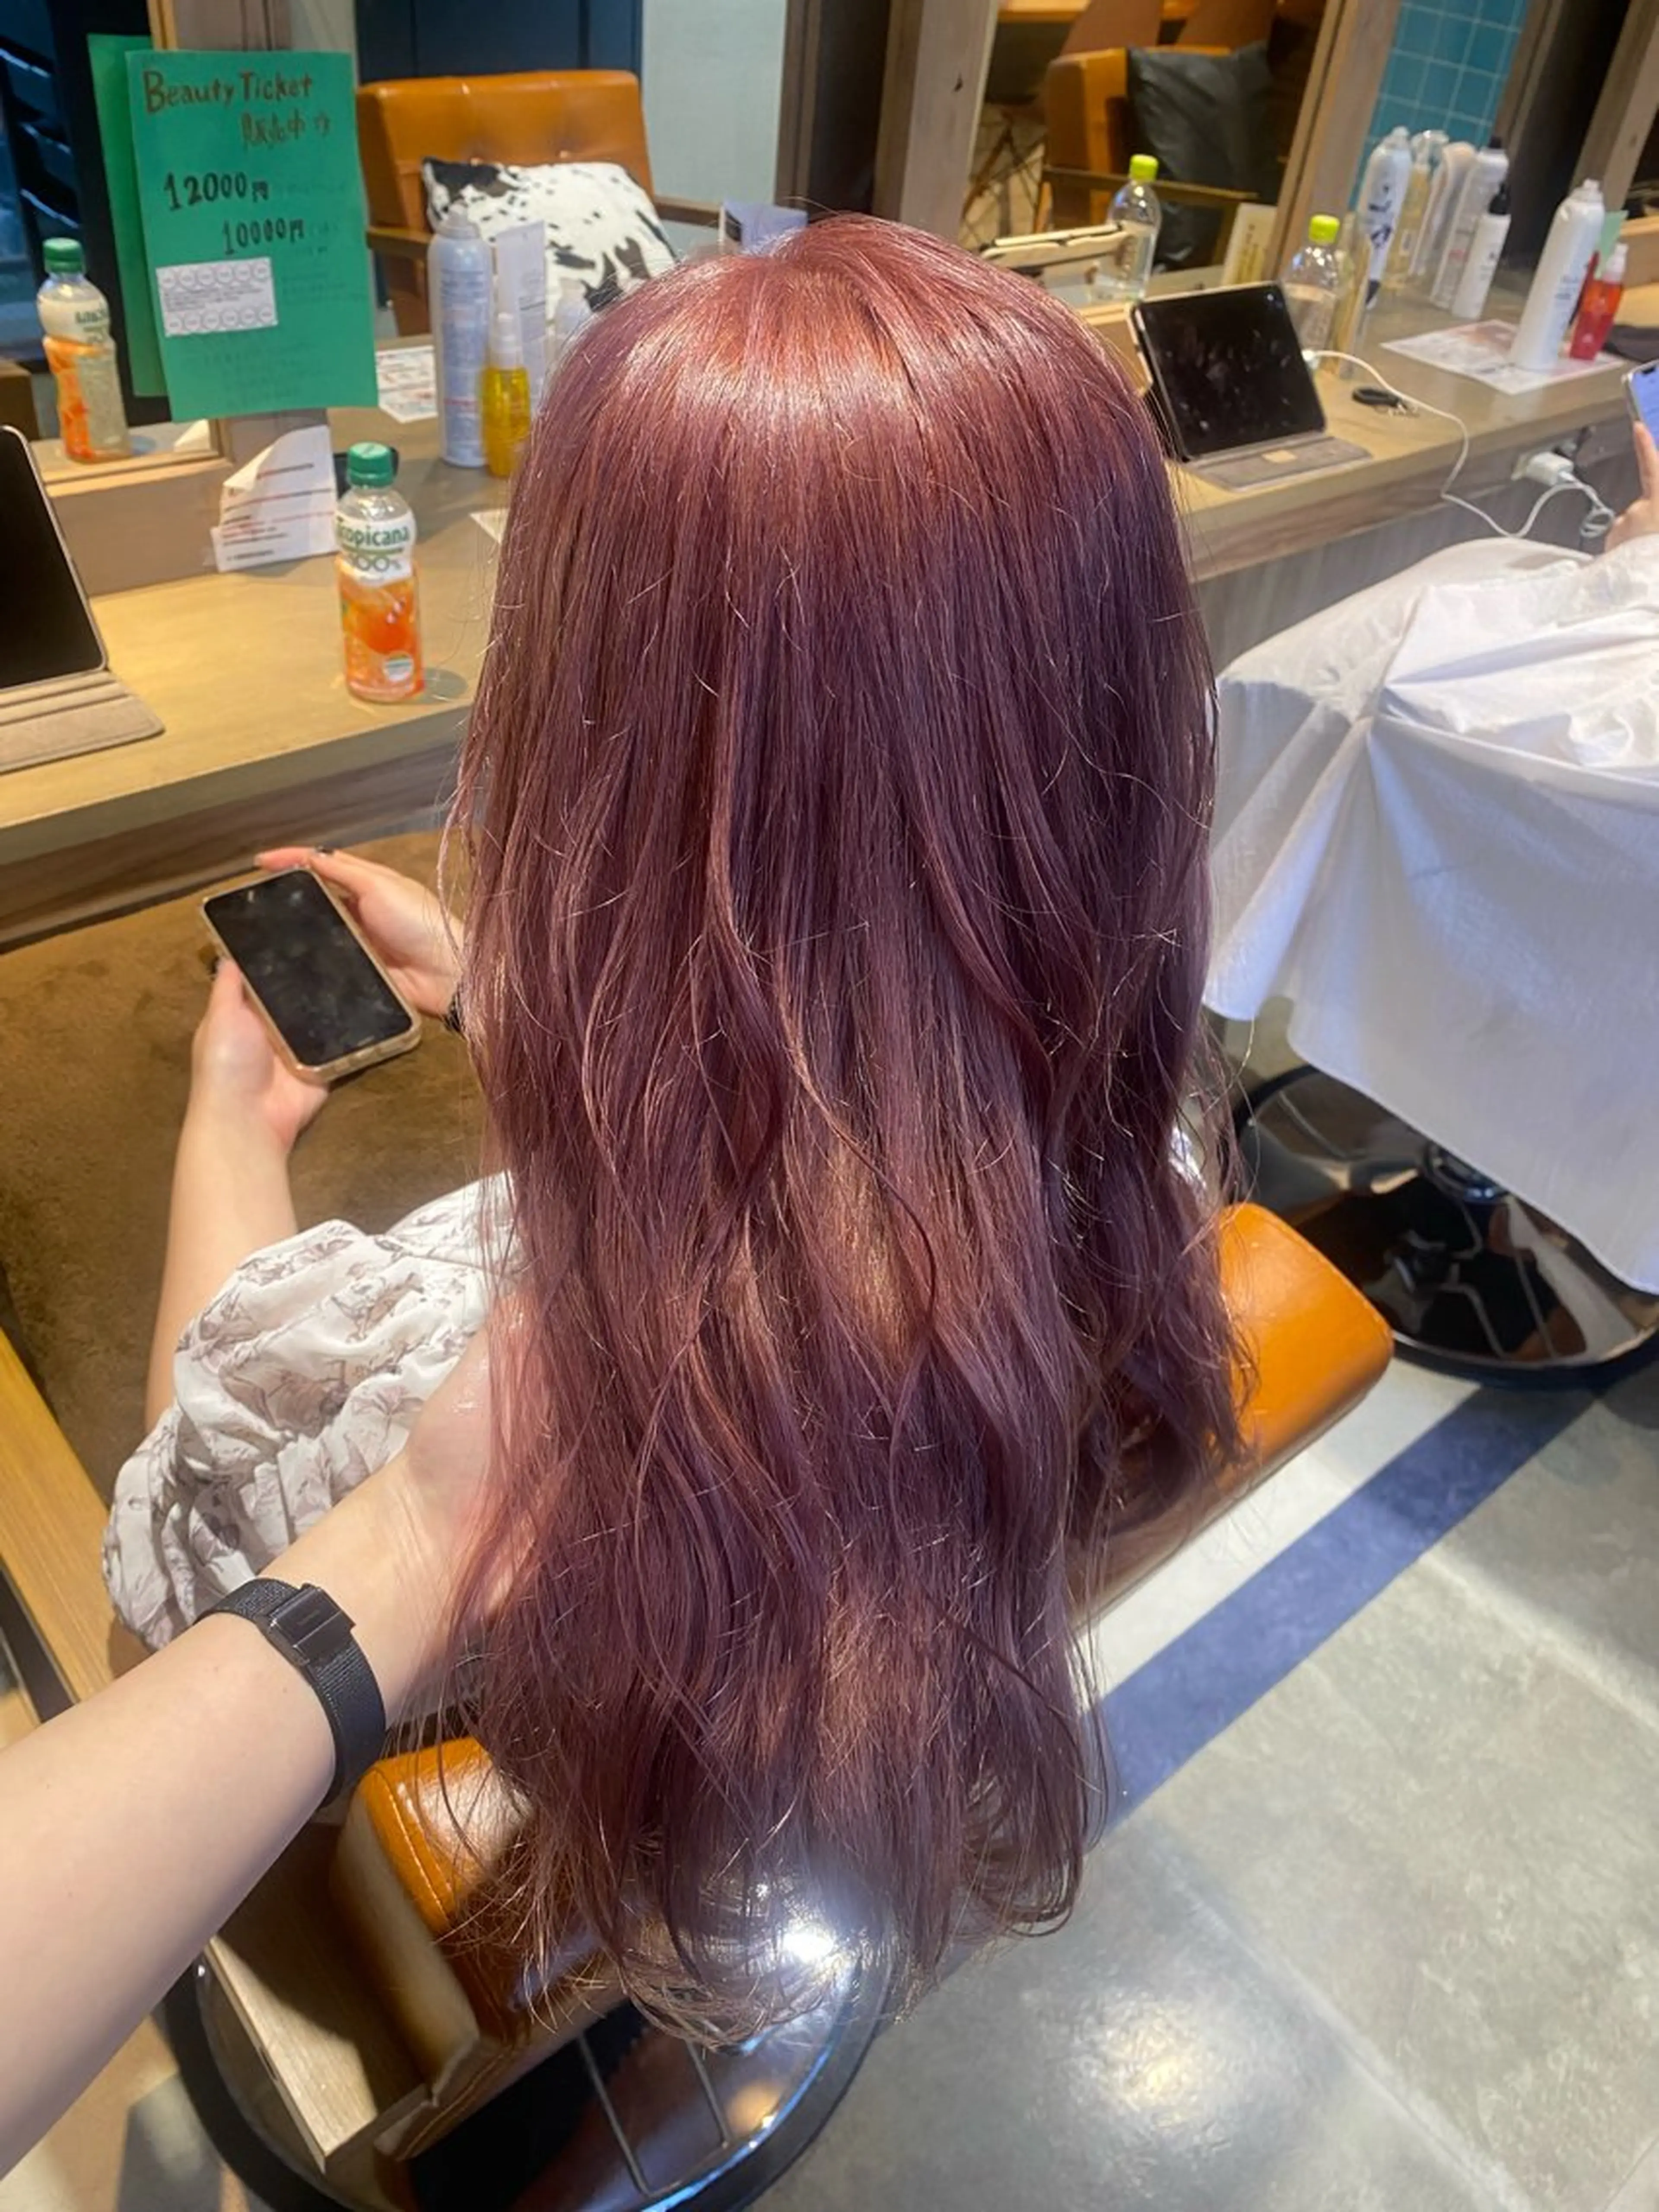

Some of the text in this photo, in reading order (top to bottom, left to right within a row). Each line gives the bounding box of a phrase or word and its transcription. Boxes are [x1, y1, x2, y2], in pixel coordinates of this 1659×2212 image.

[143, 70, 314, 114] Beauty Ticket
[164, 171, 270, 212] 12000円
[222, 217, 305, 255] 10000円
